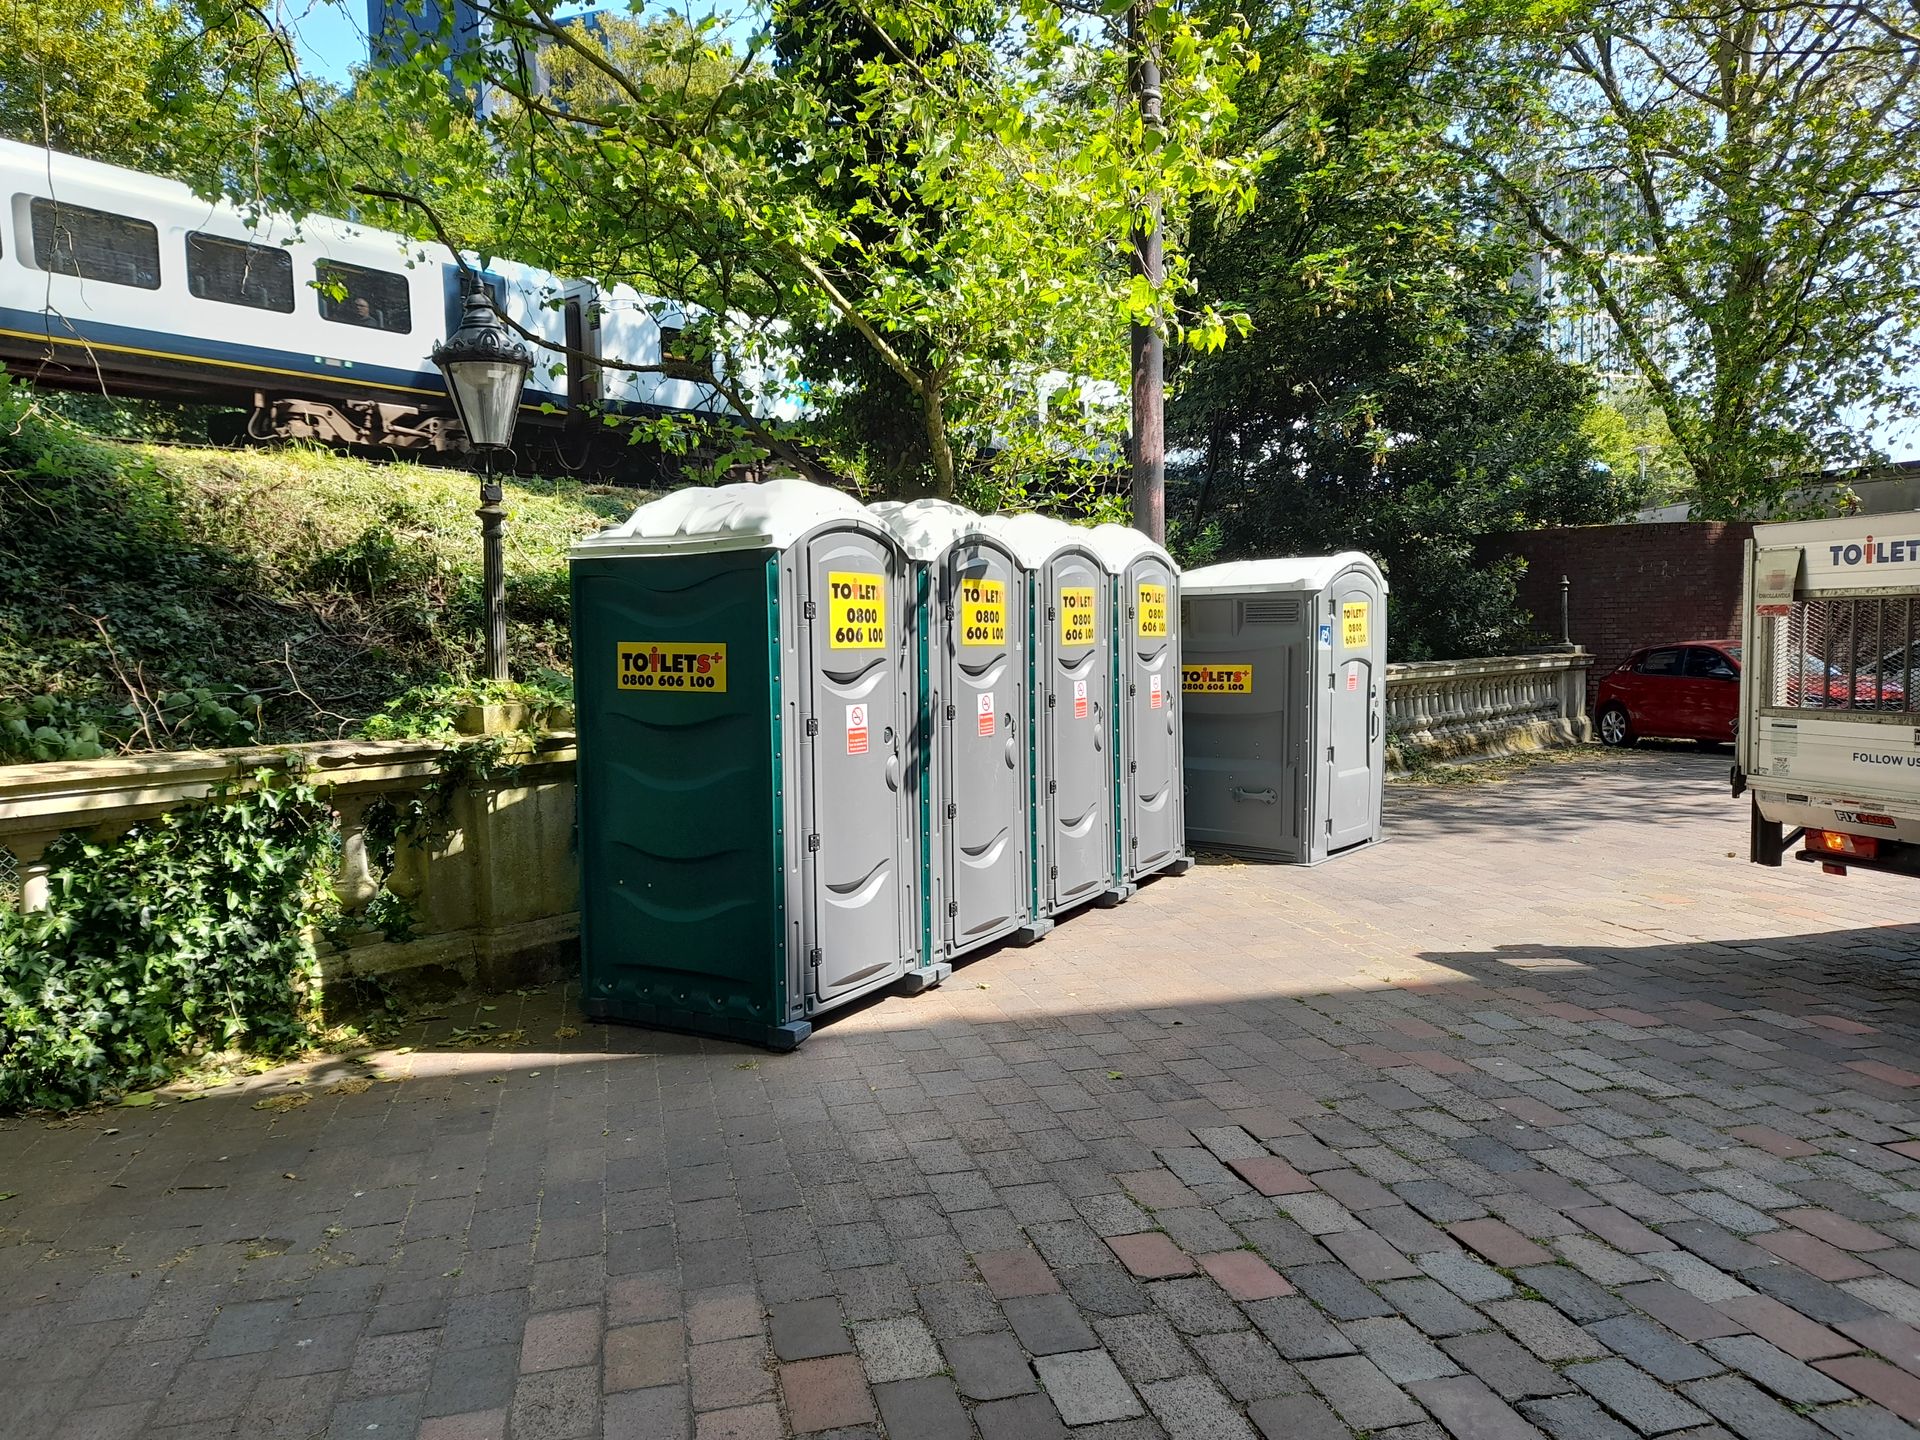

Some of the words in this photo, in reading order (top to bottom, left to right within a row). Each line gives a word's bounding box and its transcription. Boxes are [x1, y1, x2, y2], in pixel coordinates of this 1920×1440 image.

[846, 607, 877, 624] 0800
[975, 610, 999, 623] 0800
[835, 627, 863, 643] 606
[966, 626, 989, 640] 606
[1065, 629, 1083, 641] 606
[622, 674, 654, 687] 0800
[658, 674, 684, 687] 606
[1182, 683, 1204, 691] 0800
[1207, 683, 1225, 691] 606
[1853, 752, 1903, 766] FOLLOW
[1835, 811, 1860, 823] FIX
